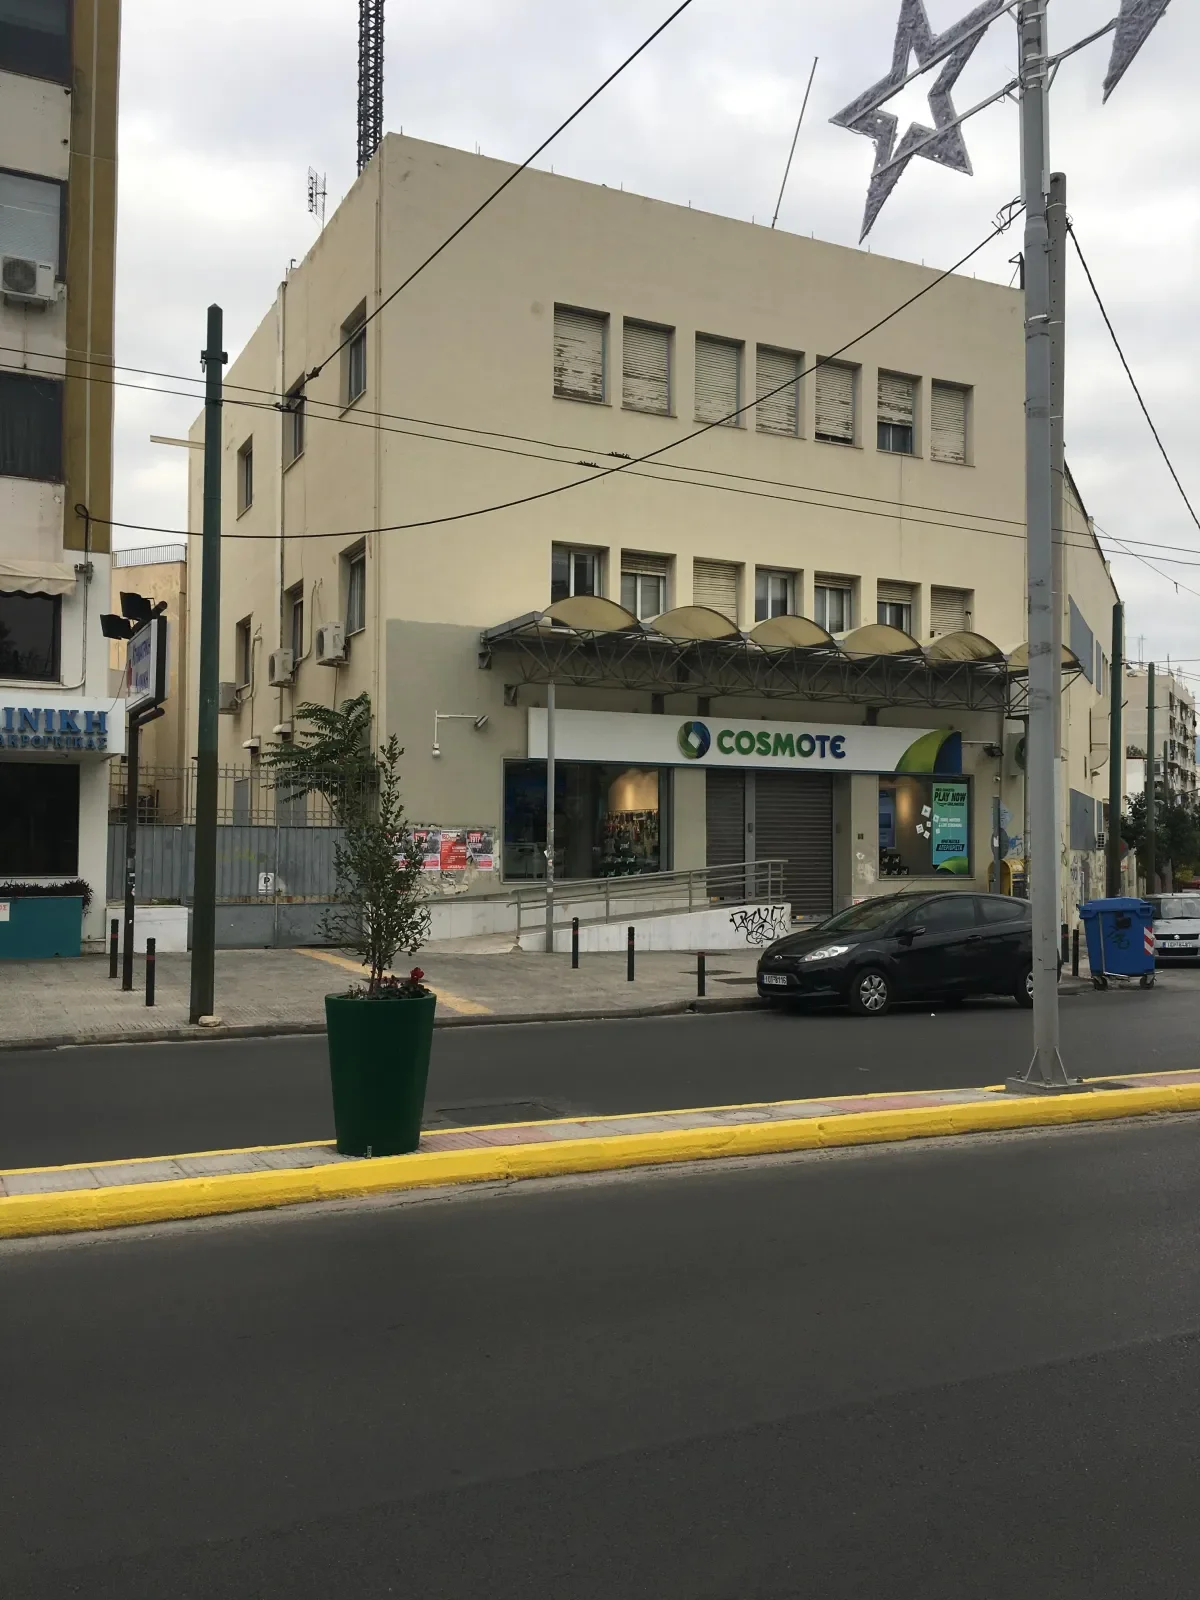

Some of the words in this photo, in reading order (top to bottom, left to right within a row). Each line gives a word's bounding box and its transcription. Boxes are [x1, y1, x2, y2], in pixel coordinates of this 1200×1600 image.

[717, 729, 846, 759] COSMOTE
[934, 791, 950, 802] PLAY
[951, 792, 967, 802] NOW
